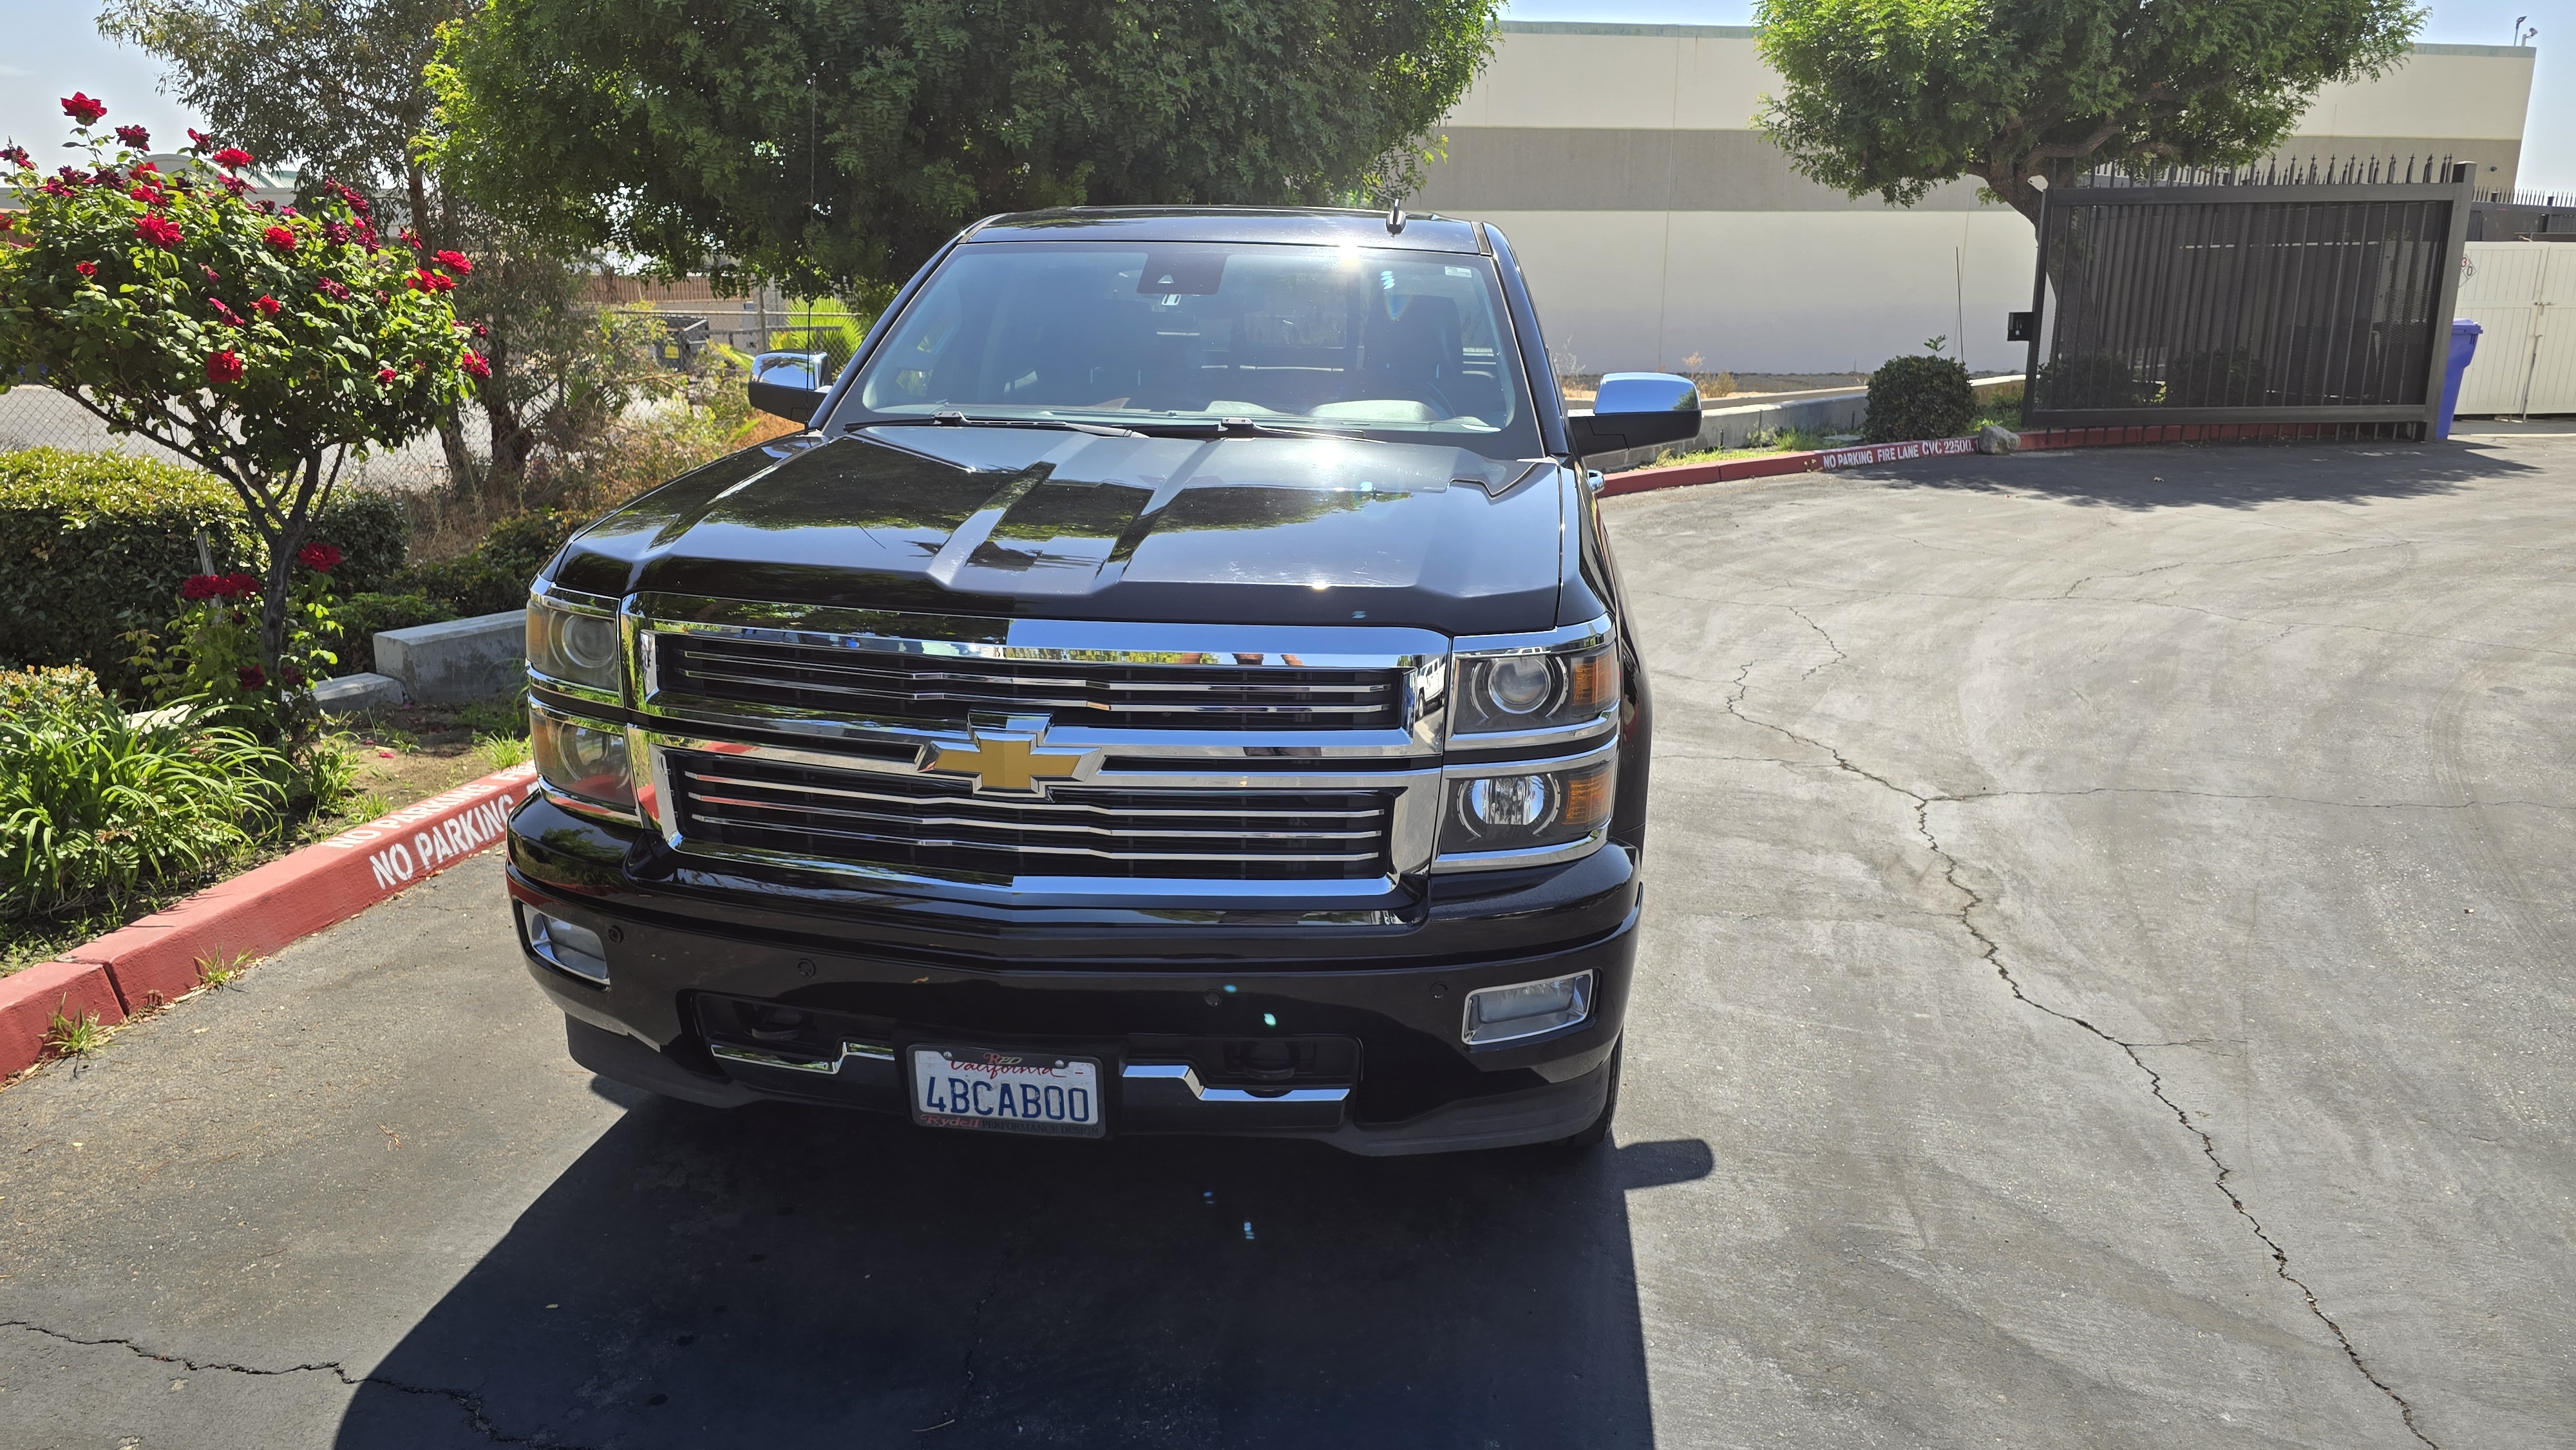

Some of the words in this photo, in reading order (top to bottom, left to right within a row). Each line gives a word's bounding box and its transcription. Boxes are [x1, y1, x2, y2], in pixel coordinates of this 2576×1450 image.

[2461, 257, 2467, 267] 3
[1823, 455, 1836, 468] NO
[1837, 450, 1873, 466] PARKING
[1877, 447, 1896, 462] FIRE
[1897, 444, 1919, 459] LANE
[1922, 440, 1942, 455] CVC
[321, 829, 382, 848] NO
[369, 784, 498, 829] PARKING
[369, 843, 413, 890] NO
[920, 1114, 980, 1128] Rydell
[981, 1120, 1058, 1134] PERFORMANCE
[1059, 1125, 1099, 1136] DESIGN
